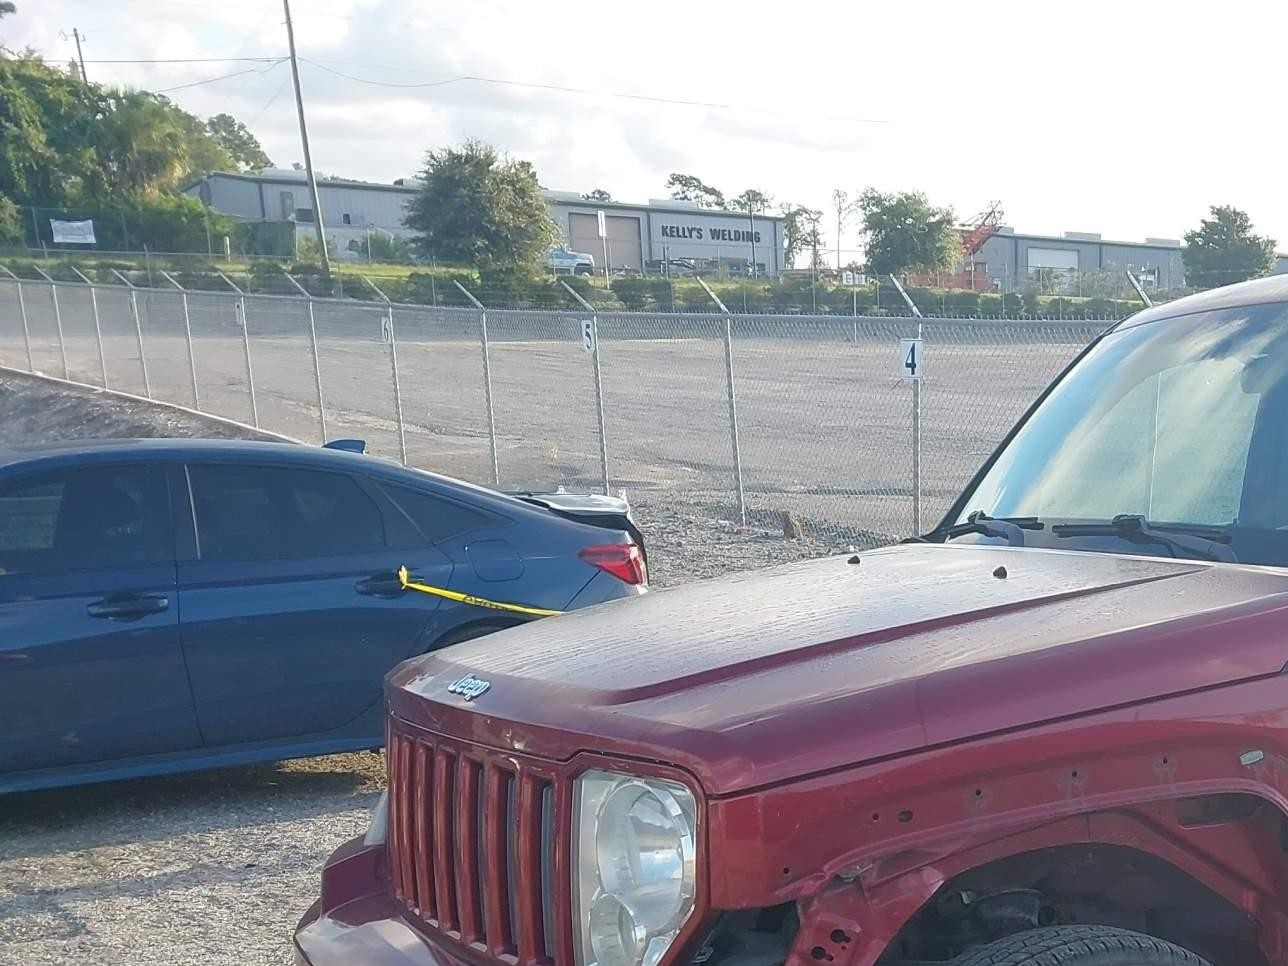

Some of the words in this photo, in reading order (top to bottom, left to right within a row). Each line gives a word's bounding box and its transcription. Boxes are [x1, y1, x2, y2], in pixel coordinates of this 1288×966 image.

[661, 224, 703, 240] KELLY'S
[709, 228, 761, 243] WELDING
[584, 323, 592, 349] 5
[905, 342, 917, 375] 4
[448, 673, 489, 700] Jeep
